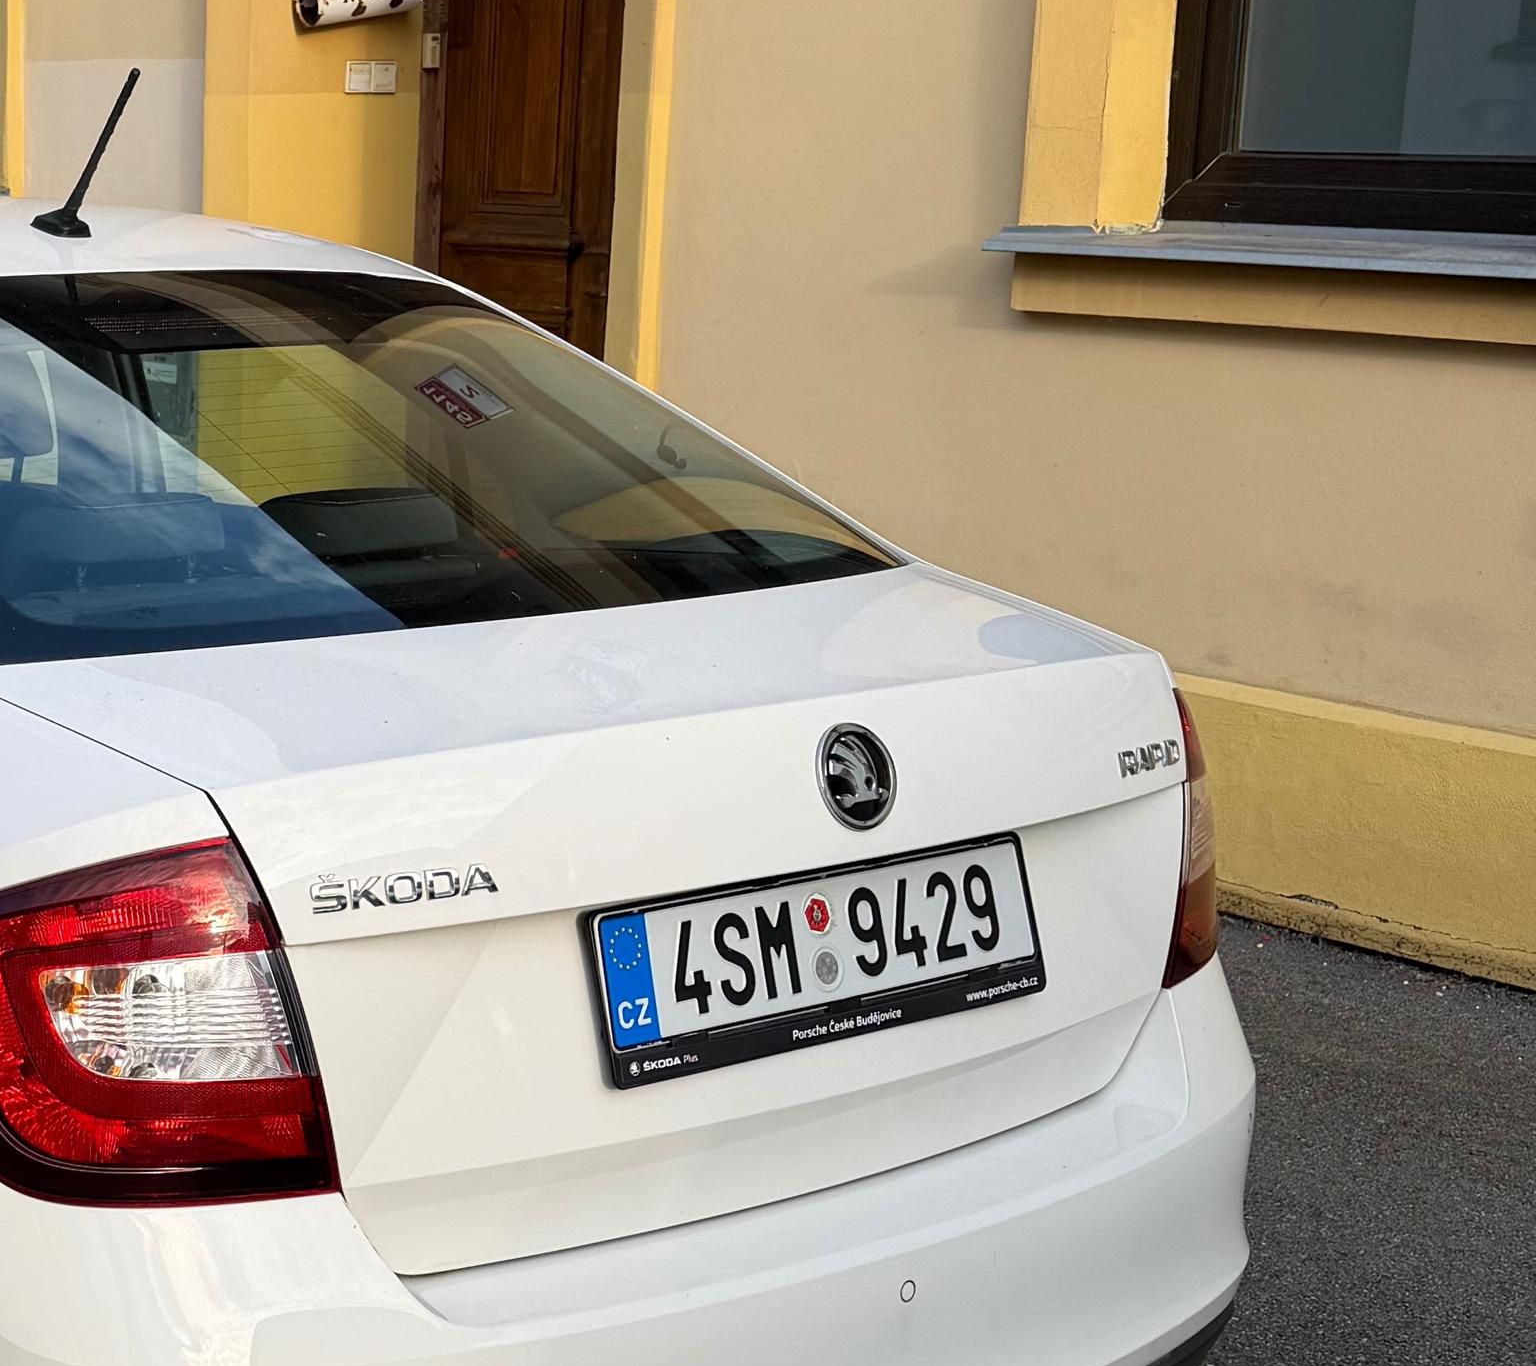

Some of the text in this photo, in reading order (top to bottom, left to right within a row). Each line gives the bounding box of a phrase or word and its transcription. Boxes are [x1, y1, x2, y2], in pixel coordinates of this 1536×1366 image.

[1117, 739, 1181, 778] RAPID
[309, 862, 499, 914] ŠKODA
[617, 864, 1000, 1029] CZ 4SM 9429
[965, 976, 1039, 1002] www.porsche-cb.cz
[792, 1007, 902, 1041] Porsche České Budějovice
[642, 1053, 699, 1072] ŠKODA Plus
